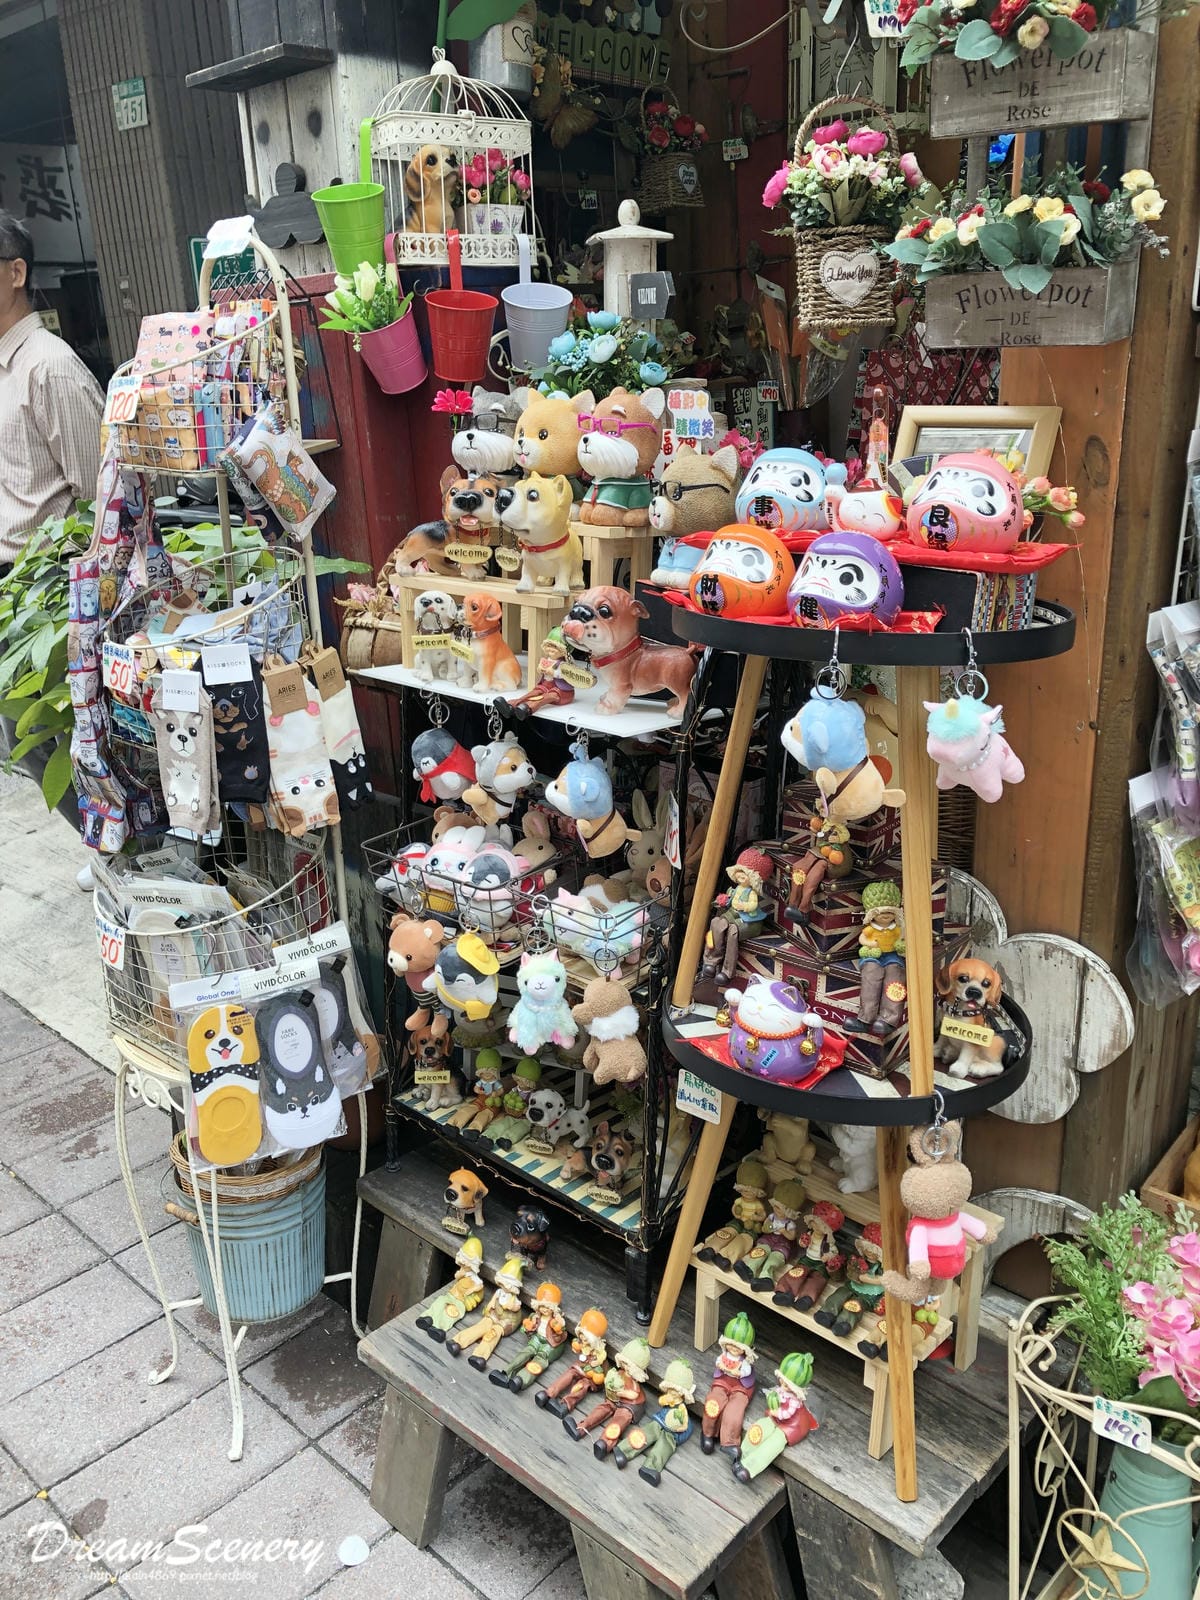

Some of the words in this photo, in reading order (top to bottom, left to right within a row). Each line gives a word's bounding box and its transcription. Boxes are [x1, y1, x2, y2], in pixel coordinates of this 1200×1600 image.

[535, 28, 670, 78] WELCOME
[1018, 81, 1040, 98] DE
[123, 99, 143, 124] 151
[1006, 105, 1051, 121] Rose
[836, 267, 856, 280] Love
[855, 265, 873, 283] You
[955, 284, 1093, 314] Flowepot
[1010, 311, 1031, 325] DE
[1000, 332, 1041, 345] Rose
[669, 391, 707, 410] 攝影中
[762, 388, 777, 400] 490
[109, 391, 135, 422] 120
[675, 418, 713, 437] 請微笑
[447, 548, 489, 558] welcome
[415, 639, 448, 647] welcome
[110, 659, 129, 690] 50
[322, 668, 337, 681] ARIES
[561, 669, 591, 684] welcome
[277, 684, 297, 695] ARIES
[132, 895, 155, 904] VIVID
[155, 896, 183, 905] COLOR
[101, 933, 119, 964] 50
[288, 947, 310, 961] VIVID
[309, 939, 338, 955] COLOR
[253, 977, 277, 991] VIVID
[276, 970, 307, 985] COLOR
[196, 991, 219, 1002] Global
[220, 989, 235, 998] One
[945, 1025, 988, 1043] welcome
[589, 1192, 619, 1203] welcome
